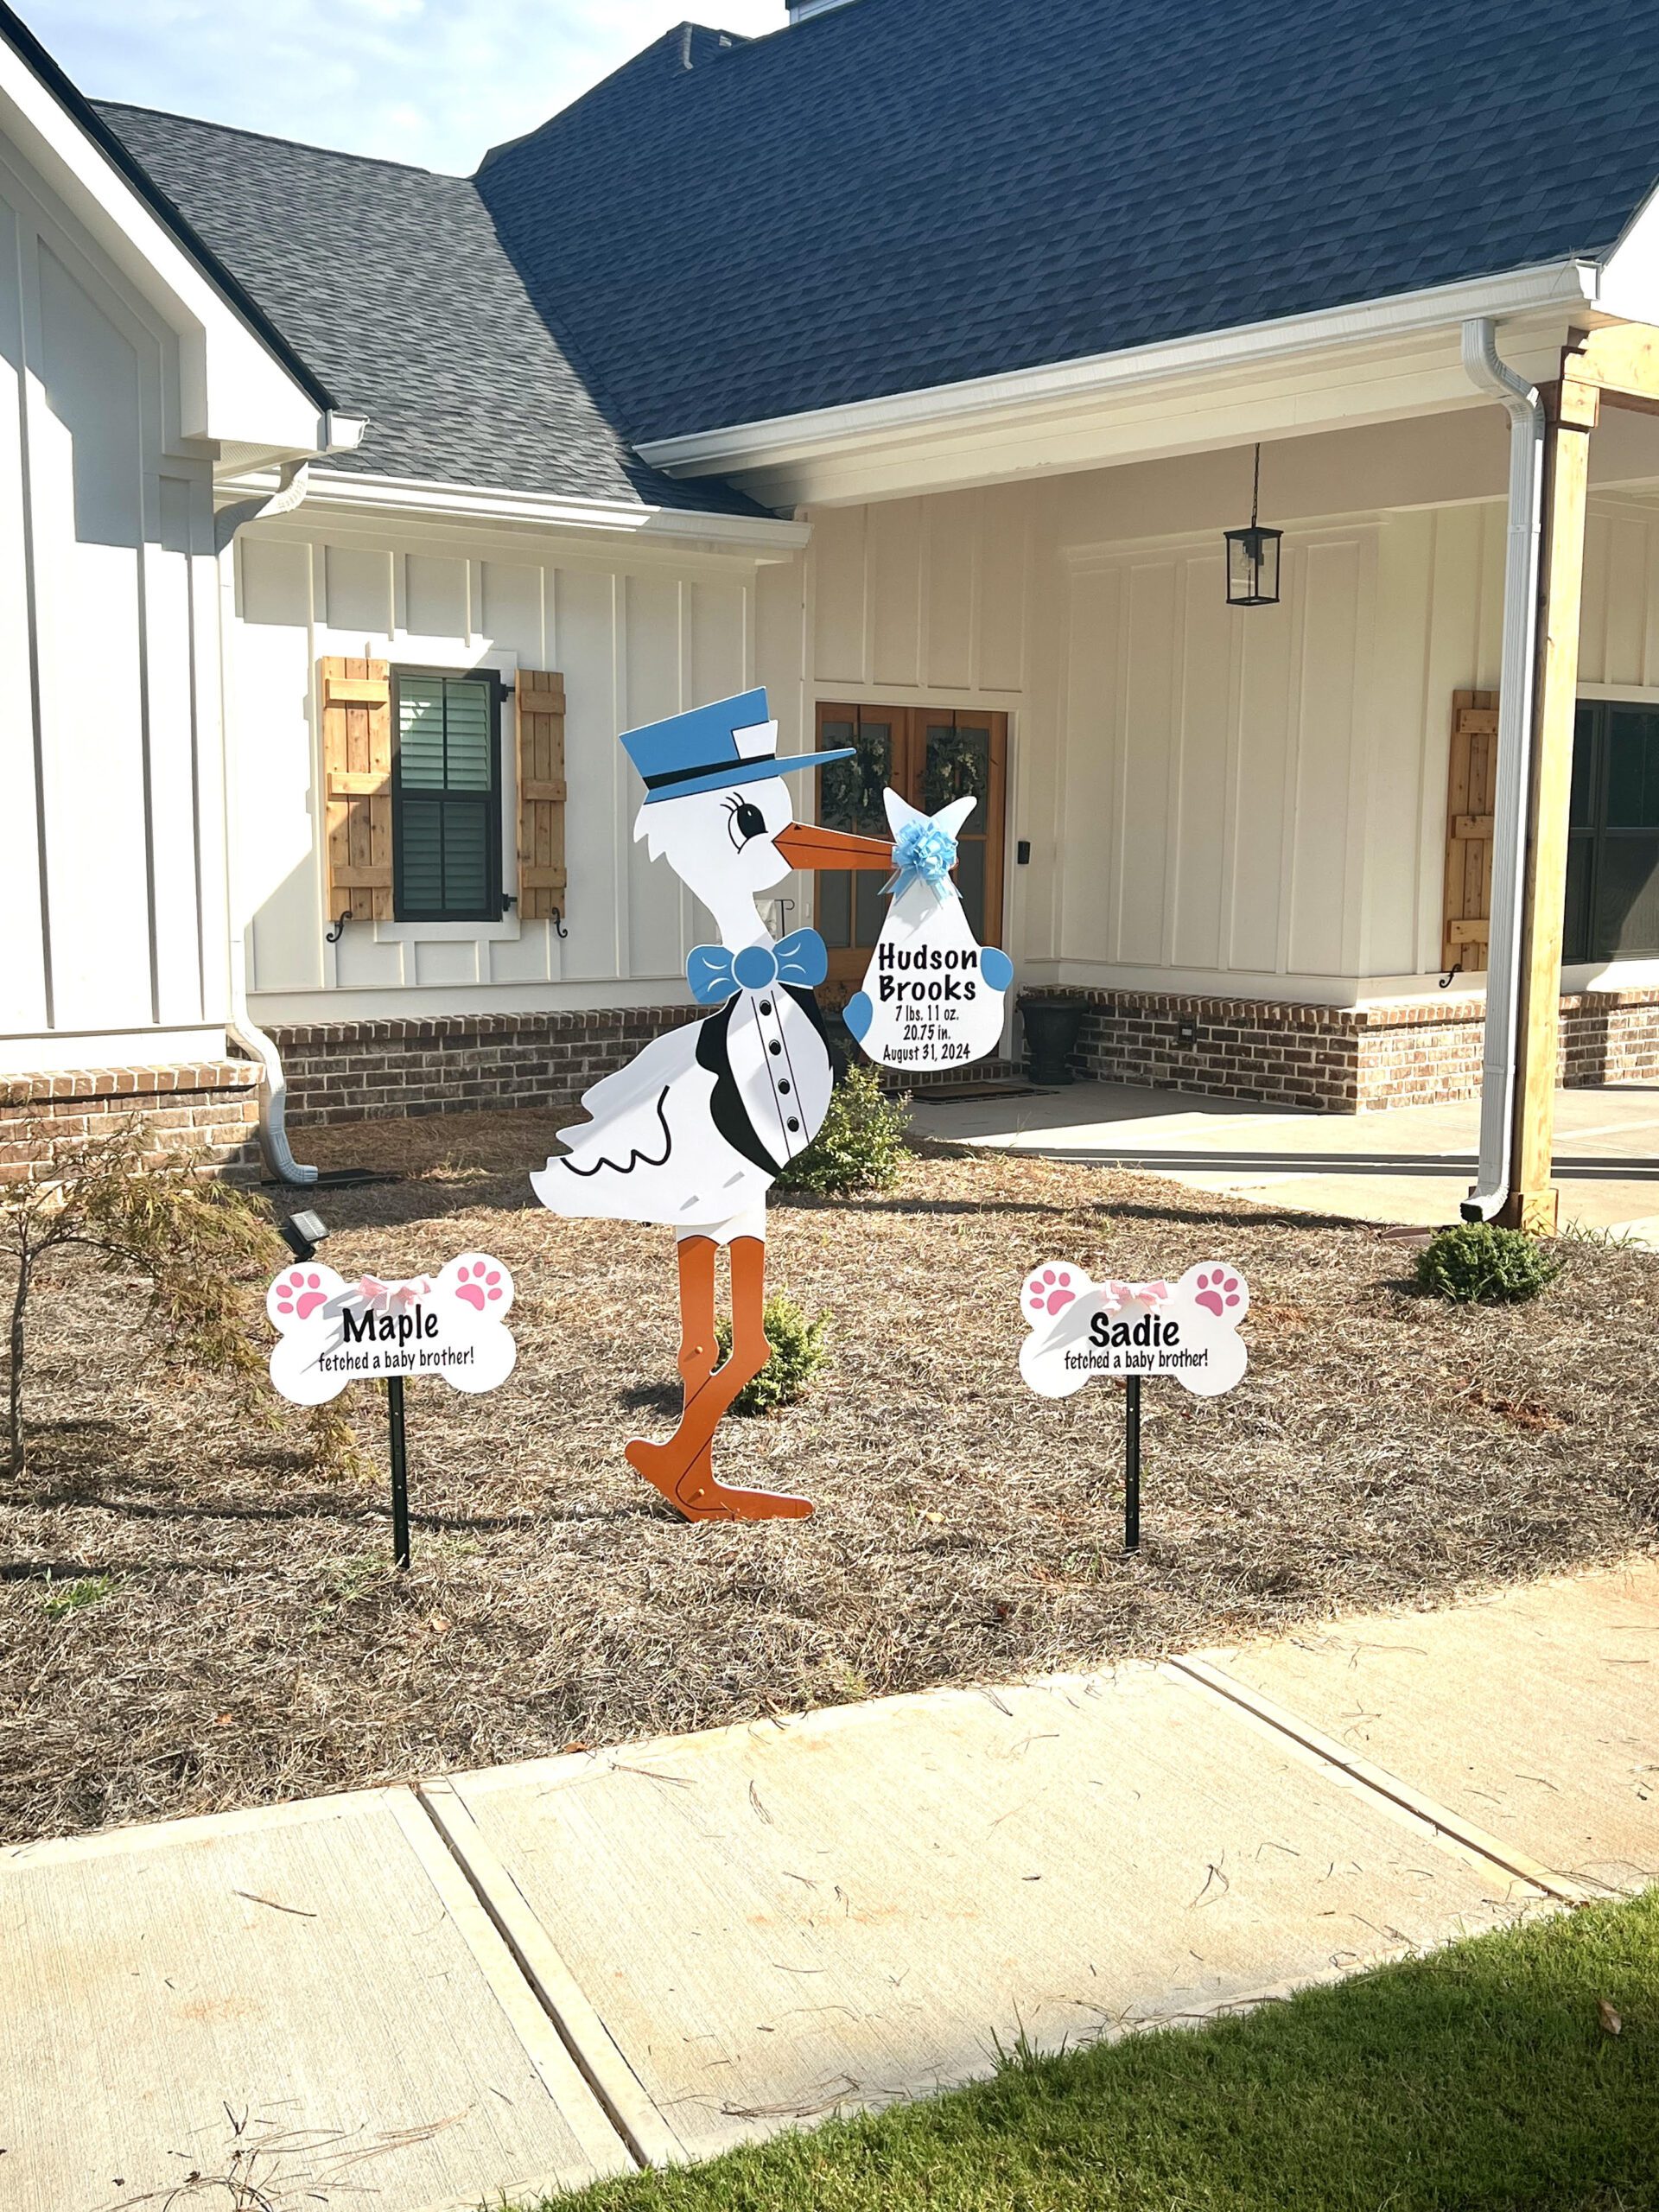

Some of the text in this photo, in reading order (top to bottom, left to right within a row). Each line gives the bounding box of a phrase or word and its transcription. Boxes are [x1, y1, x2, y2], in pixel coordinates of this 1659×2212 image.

[878, 943, 977, 970] Hudson
[879, 974, 976, 1001] Brooks
[895, 1004, 959, 1021] 7 lbs. 11 oz.
[903, 1024, 951, 1040] 20.75 in.
[883, 1043, 970, 1064] August 31, 2024
[342, 1303, 439, 1347] Maple
[1089, 1312, 1179, 1347] Sadie
[318, 1346, 474, 1372] fetched a baby brother!
[1065, 1348, 1209, 1371] fetched a baby brother!
